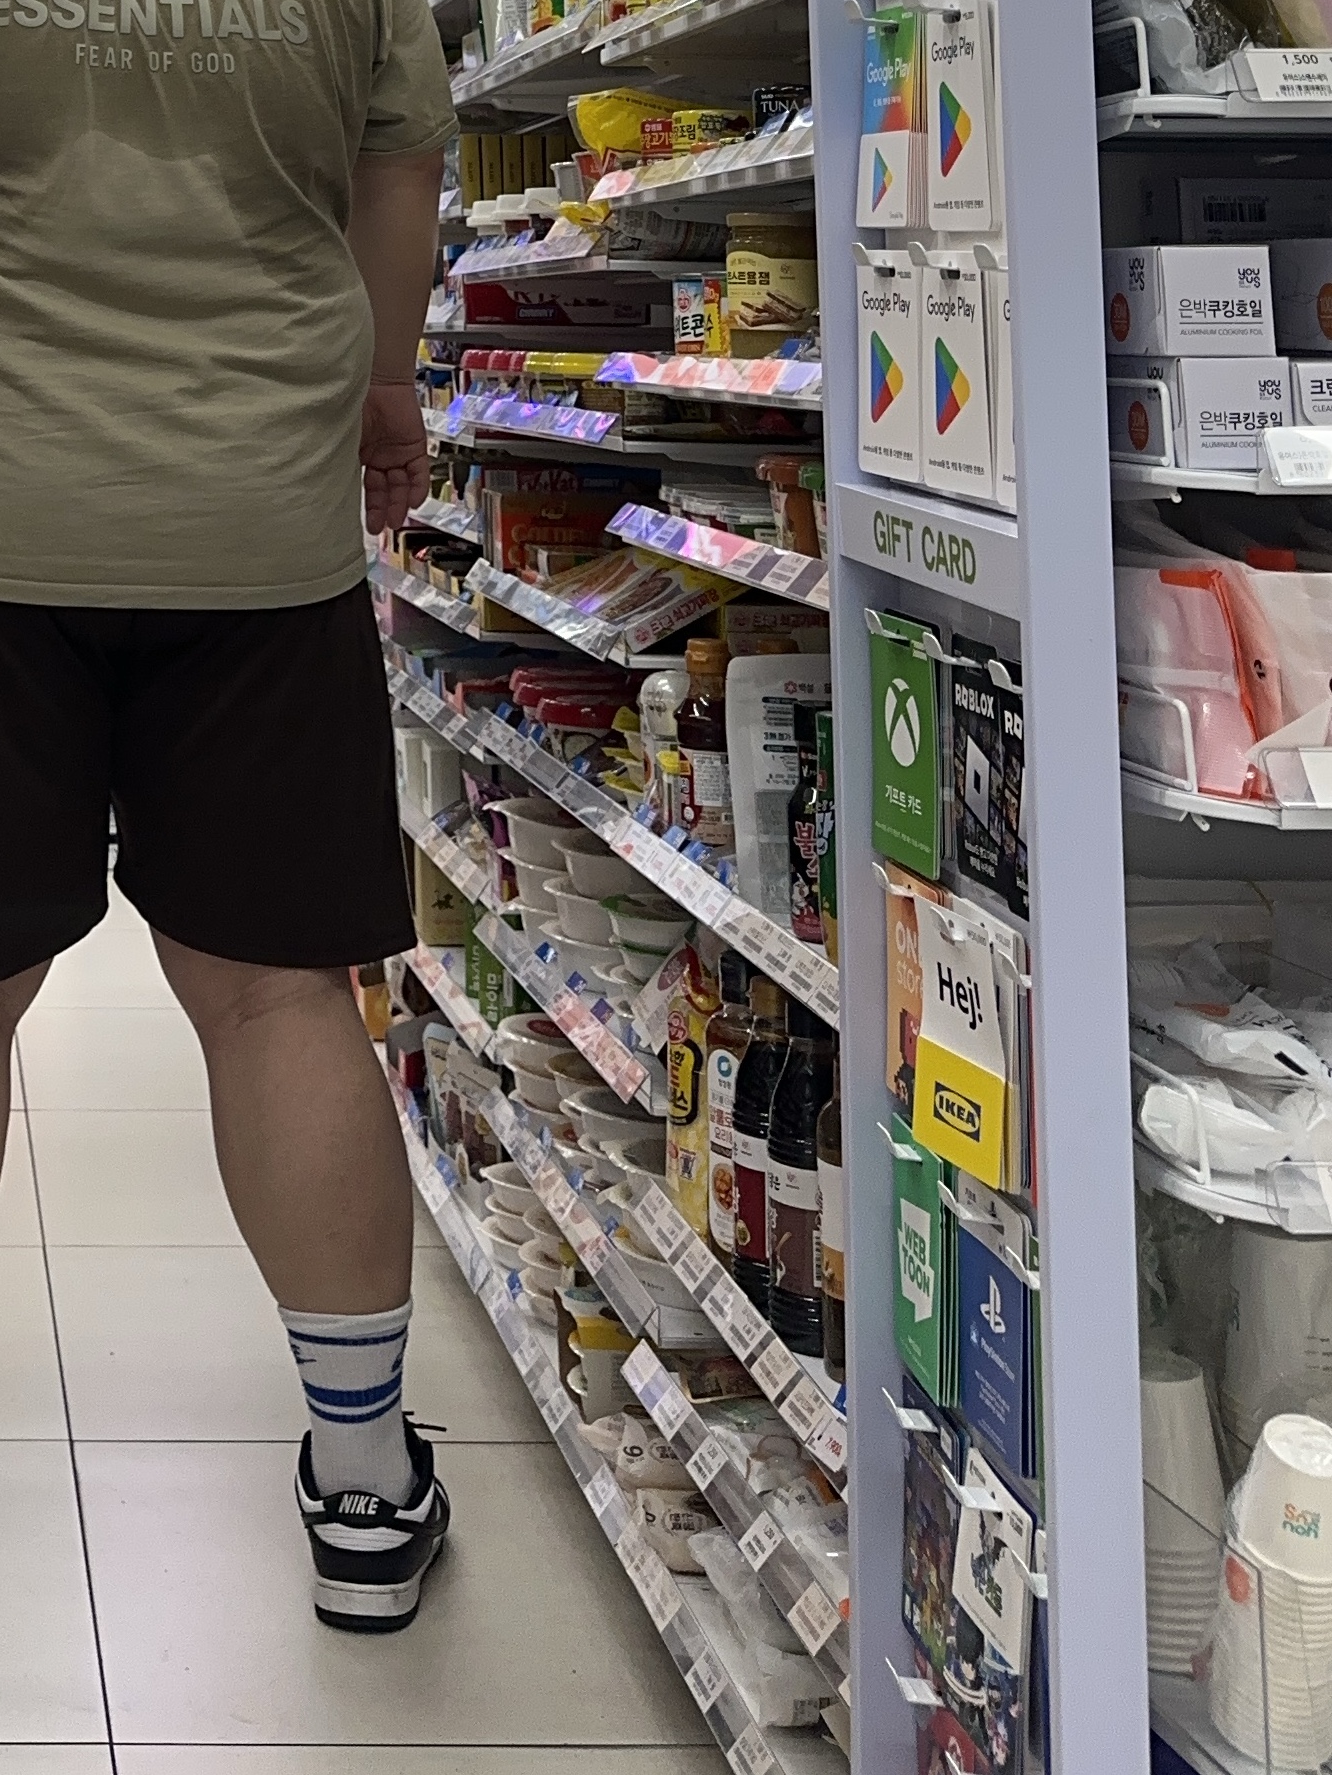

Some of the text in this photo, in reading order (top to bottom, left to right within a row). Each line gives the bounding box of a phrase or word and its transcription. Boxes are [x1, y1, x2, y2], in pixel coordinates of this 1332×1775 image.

[75, 42, 236, 74] FEAR OF GOD
[931, 36, 975, 65] Google Play
[1282, 54, 1319, 66] 1,500
[866, 57, 912, 88] Google Play
[760, 100, 800, 114] TUNA
[861, 289, 911, 319] Google Play
[926, 293, 956, 322] Google
[957, 296, 976, 324] Play
[1178, 297, 1264, 320] 은박쿠킹호일
[872, 509, 978, 586] GIFT CARD
[954, 682, 995, 720] ROBLOX
[884, 783, 923, 816] 기프트 카드
[936, 961, 984, 1031] Hej!
[938, 1094, 980, 1130] IKEA
[903, 1221, 927, 1267] WEB
[901, 1242, 931, 1298] TOON
[338, 1492, 381, 1518] NIKE
